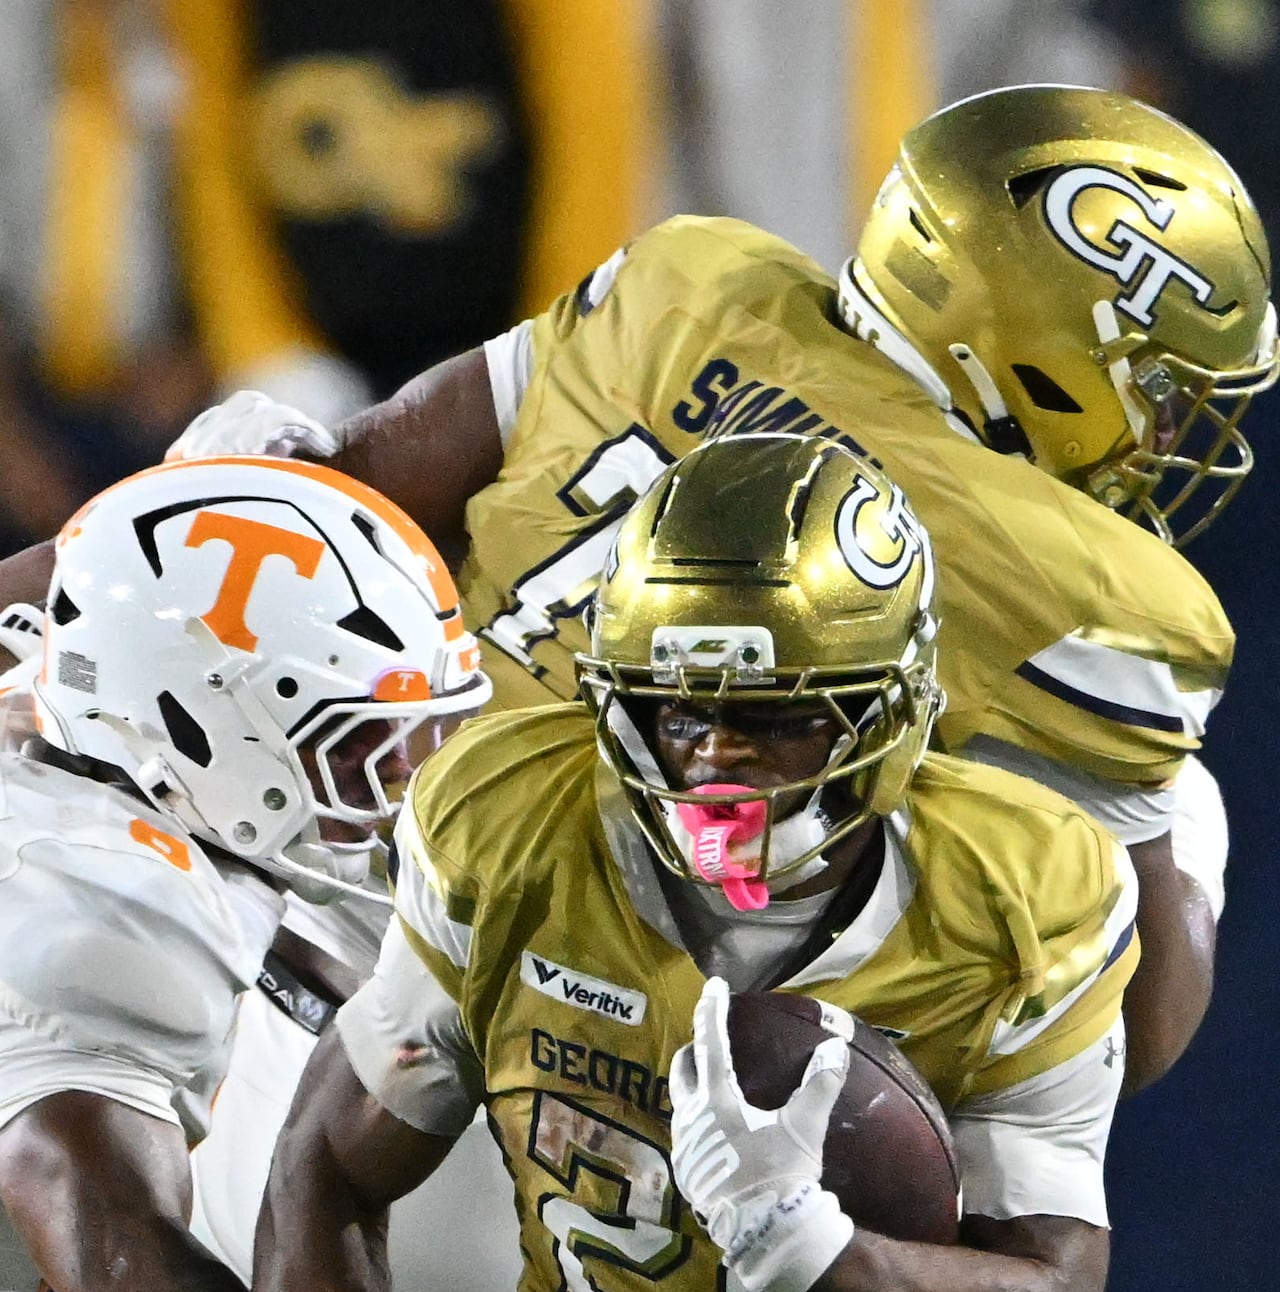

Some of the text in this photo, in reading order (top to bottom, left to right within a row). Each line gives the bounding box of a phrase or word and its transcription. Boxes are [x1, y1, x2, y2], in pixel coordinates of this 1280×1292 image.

[1041, 163, 1216, 331] GT
[183, 510, 327, 654] T
[396, 672, 415, 692] T
